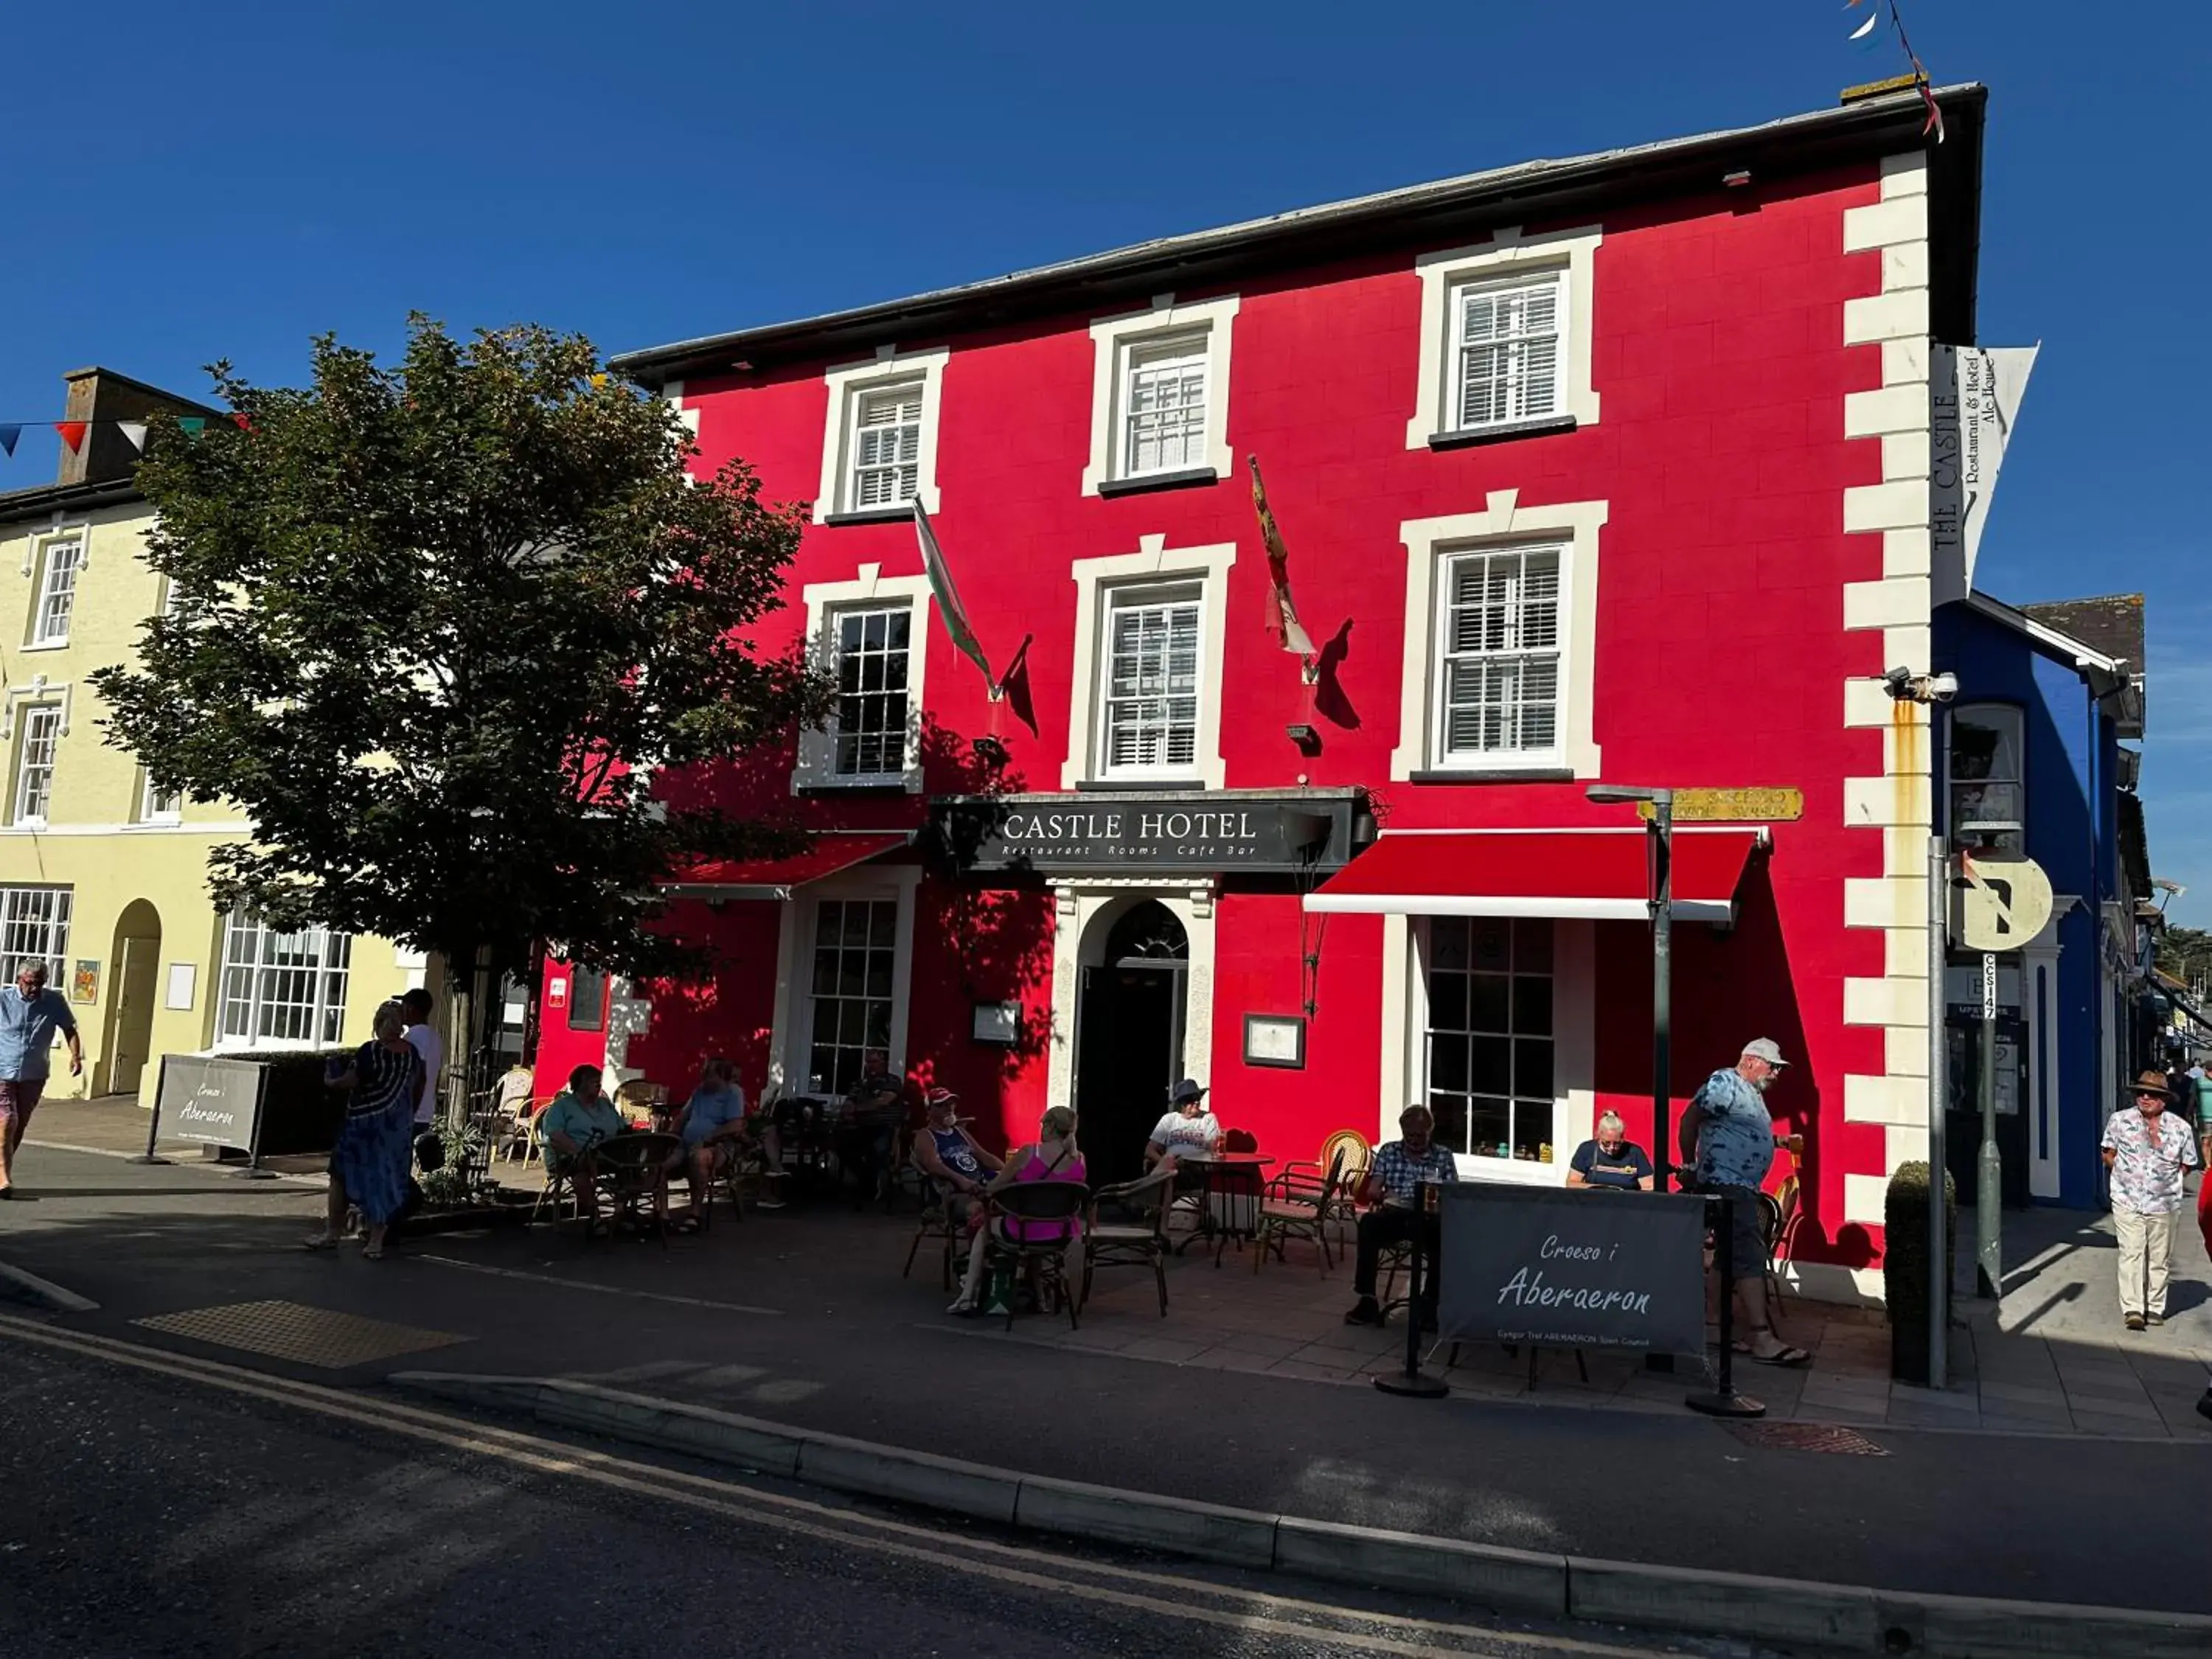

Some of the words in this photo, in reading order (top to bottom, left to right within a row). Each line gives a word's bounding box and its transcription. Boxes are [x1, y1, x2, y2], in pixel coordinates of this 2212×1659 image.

[1964, 356, 1978, 392] Hotel
[1966, 397, 1978, 408] &
[1982, 402, 1994, 423] Ale
[1935, 394, 1958, 488] CASTLE
[1966, 417, 1978, 484] Restaurant
[1935, 504, 1958, 550] THE
[1004, 815, 1121, 839] CASTLE
[1140, 813, 1256, 838] HOTEL
[1002, 846, 1090, 855] Restaurant
[1108, 846, 1158, 855] Rooms
[1226, 846, 1256, 855] Bar
[1540, 1235, 1601, 1261] Croeso
[1609, 1242, 1619, 1262] i
[1498, 1266, 1651, 1315] Aberaeron
